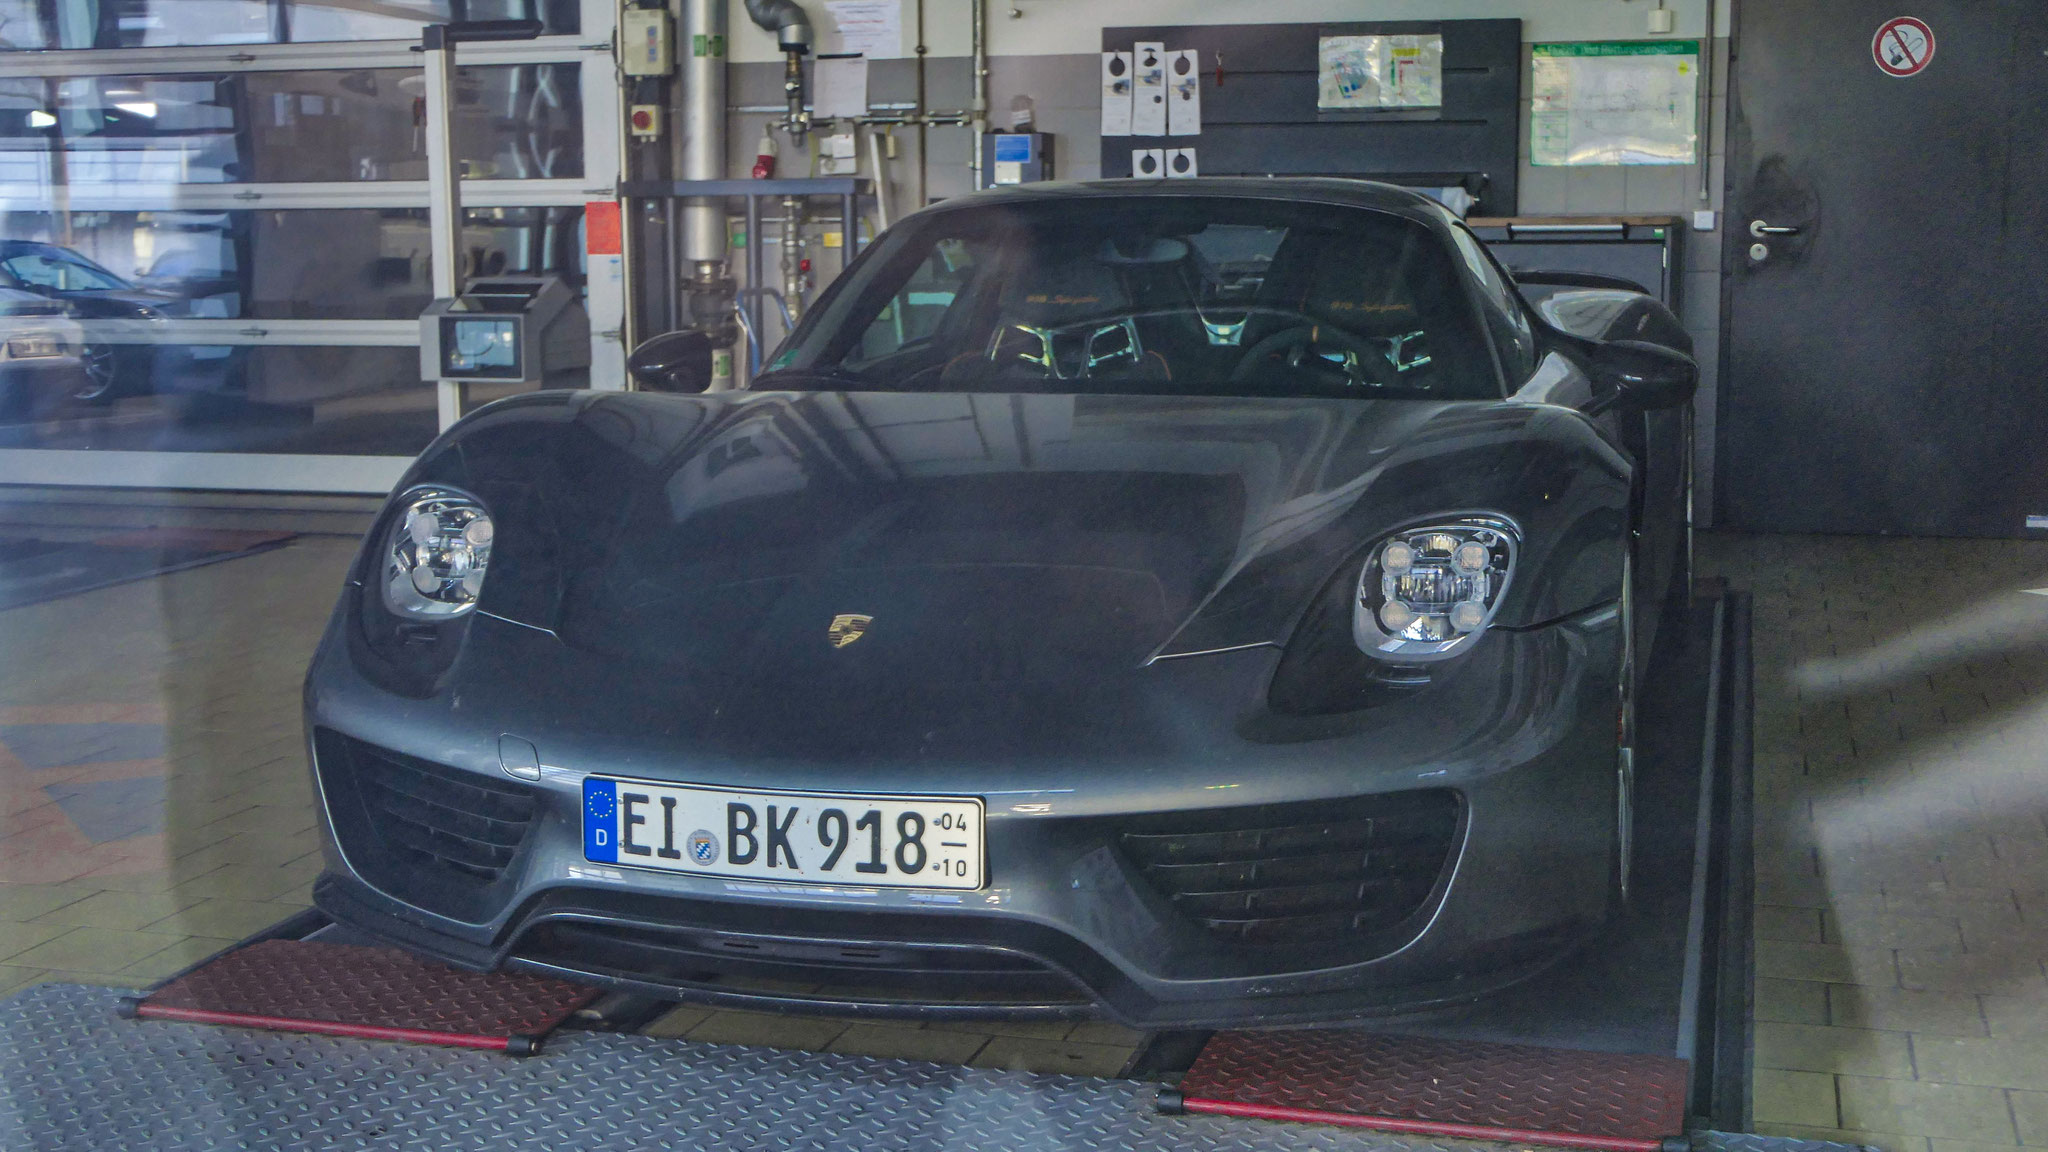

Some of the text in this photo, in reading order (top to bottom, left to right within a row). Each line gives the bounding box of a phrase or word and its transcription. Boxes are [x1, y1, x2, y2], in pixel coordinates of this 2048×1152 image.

[596, 829, 607, 846] D
[623, 792, 681, 860] EI
[727, 802, 799, 870] BK
[817, 808, 928, 875] 918
